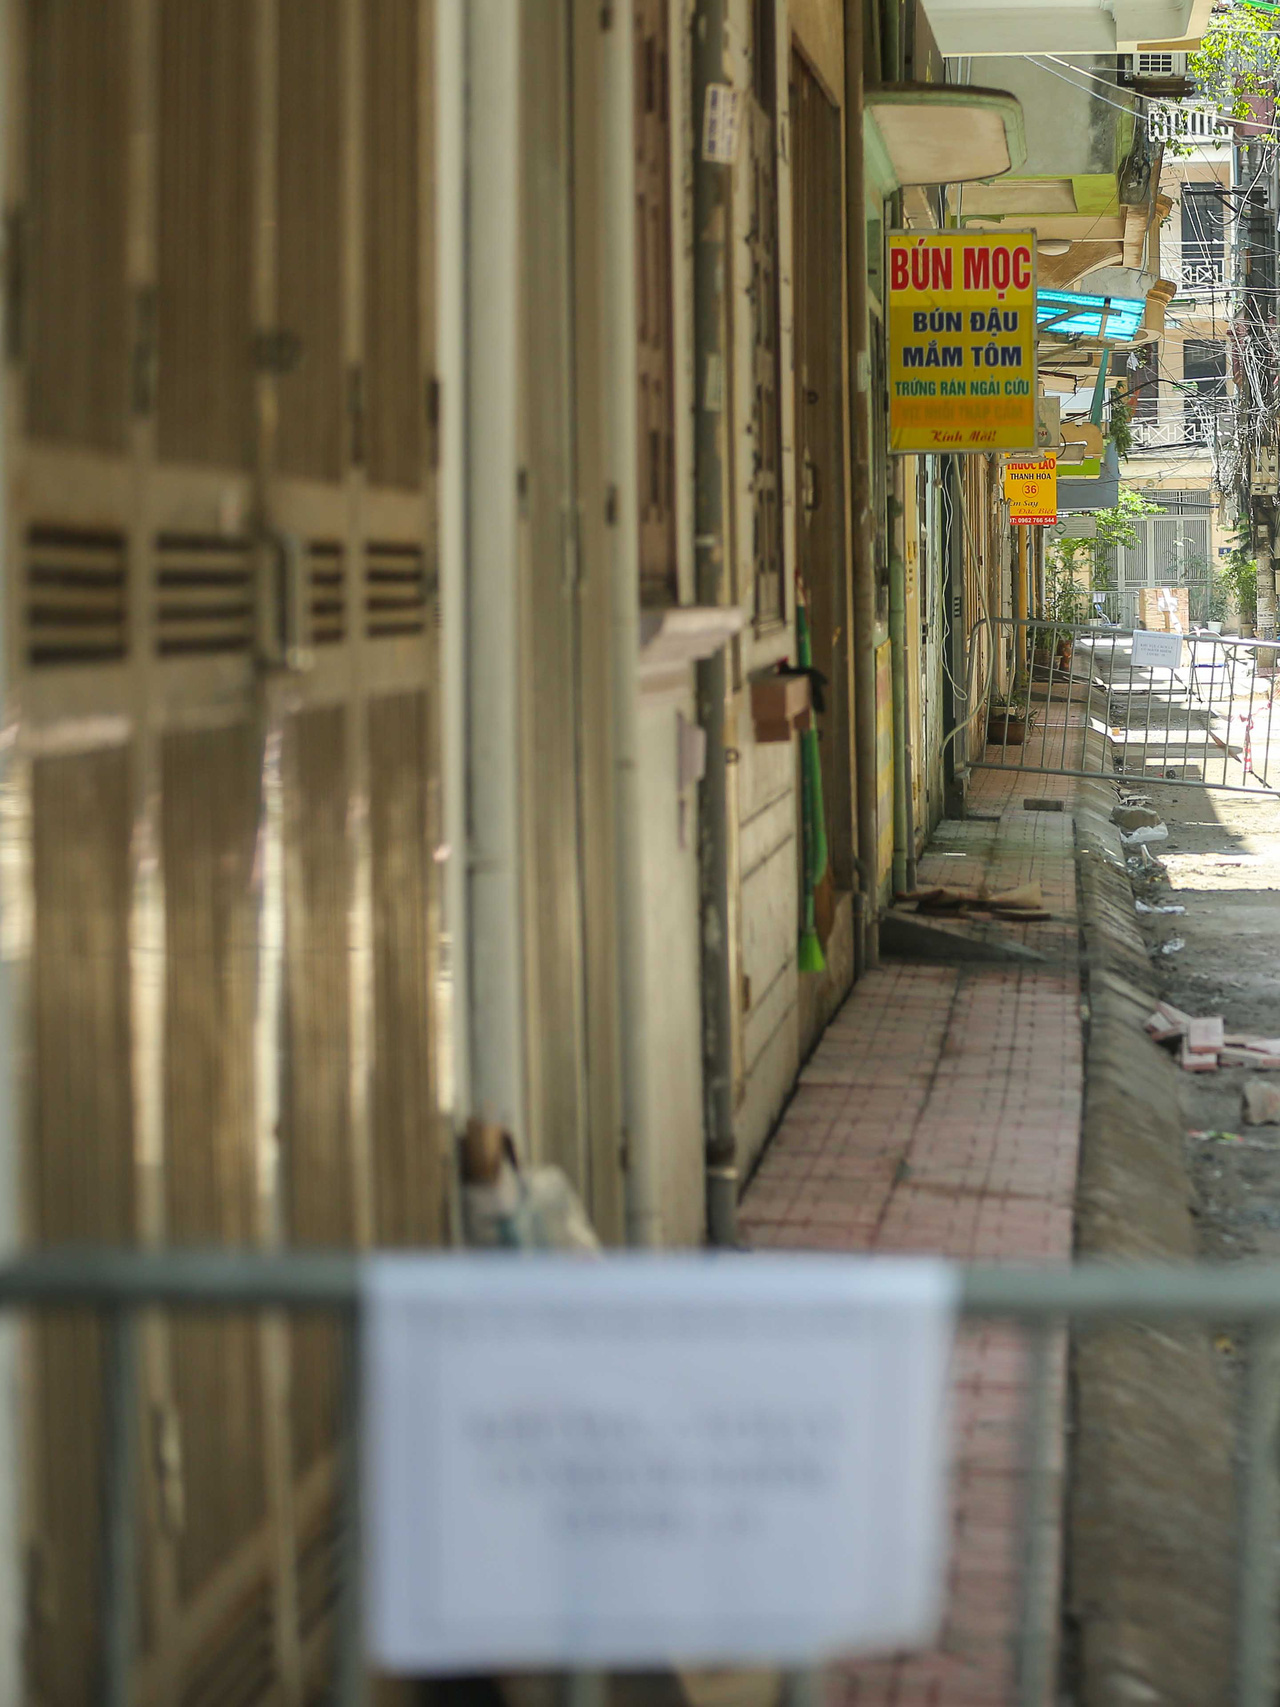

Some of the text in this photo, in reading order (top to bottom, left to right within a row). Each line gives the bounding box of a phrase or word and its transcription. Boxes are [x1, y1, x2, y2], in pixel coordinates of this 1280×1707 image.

[890, 238, 1031, 300] BÚN MỌC
[913, 307, 1018, 337] BÚN ĐẬU
[902, 339, 1022, 368] MẮM TÔM
[895, 374, 1029, 396] TRỨNG RÁN NGẢI CỨU
[931, 429, 963, 443] Kính
[1036, 471, 1051, 480] HÓA
[1024, 485, 1037, 494] 36
[1023, 500, 1039, 508] Say
